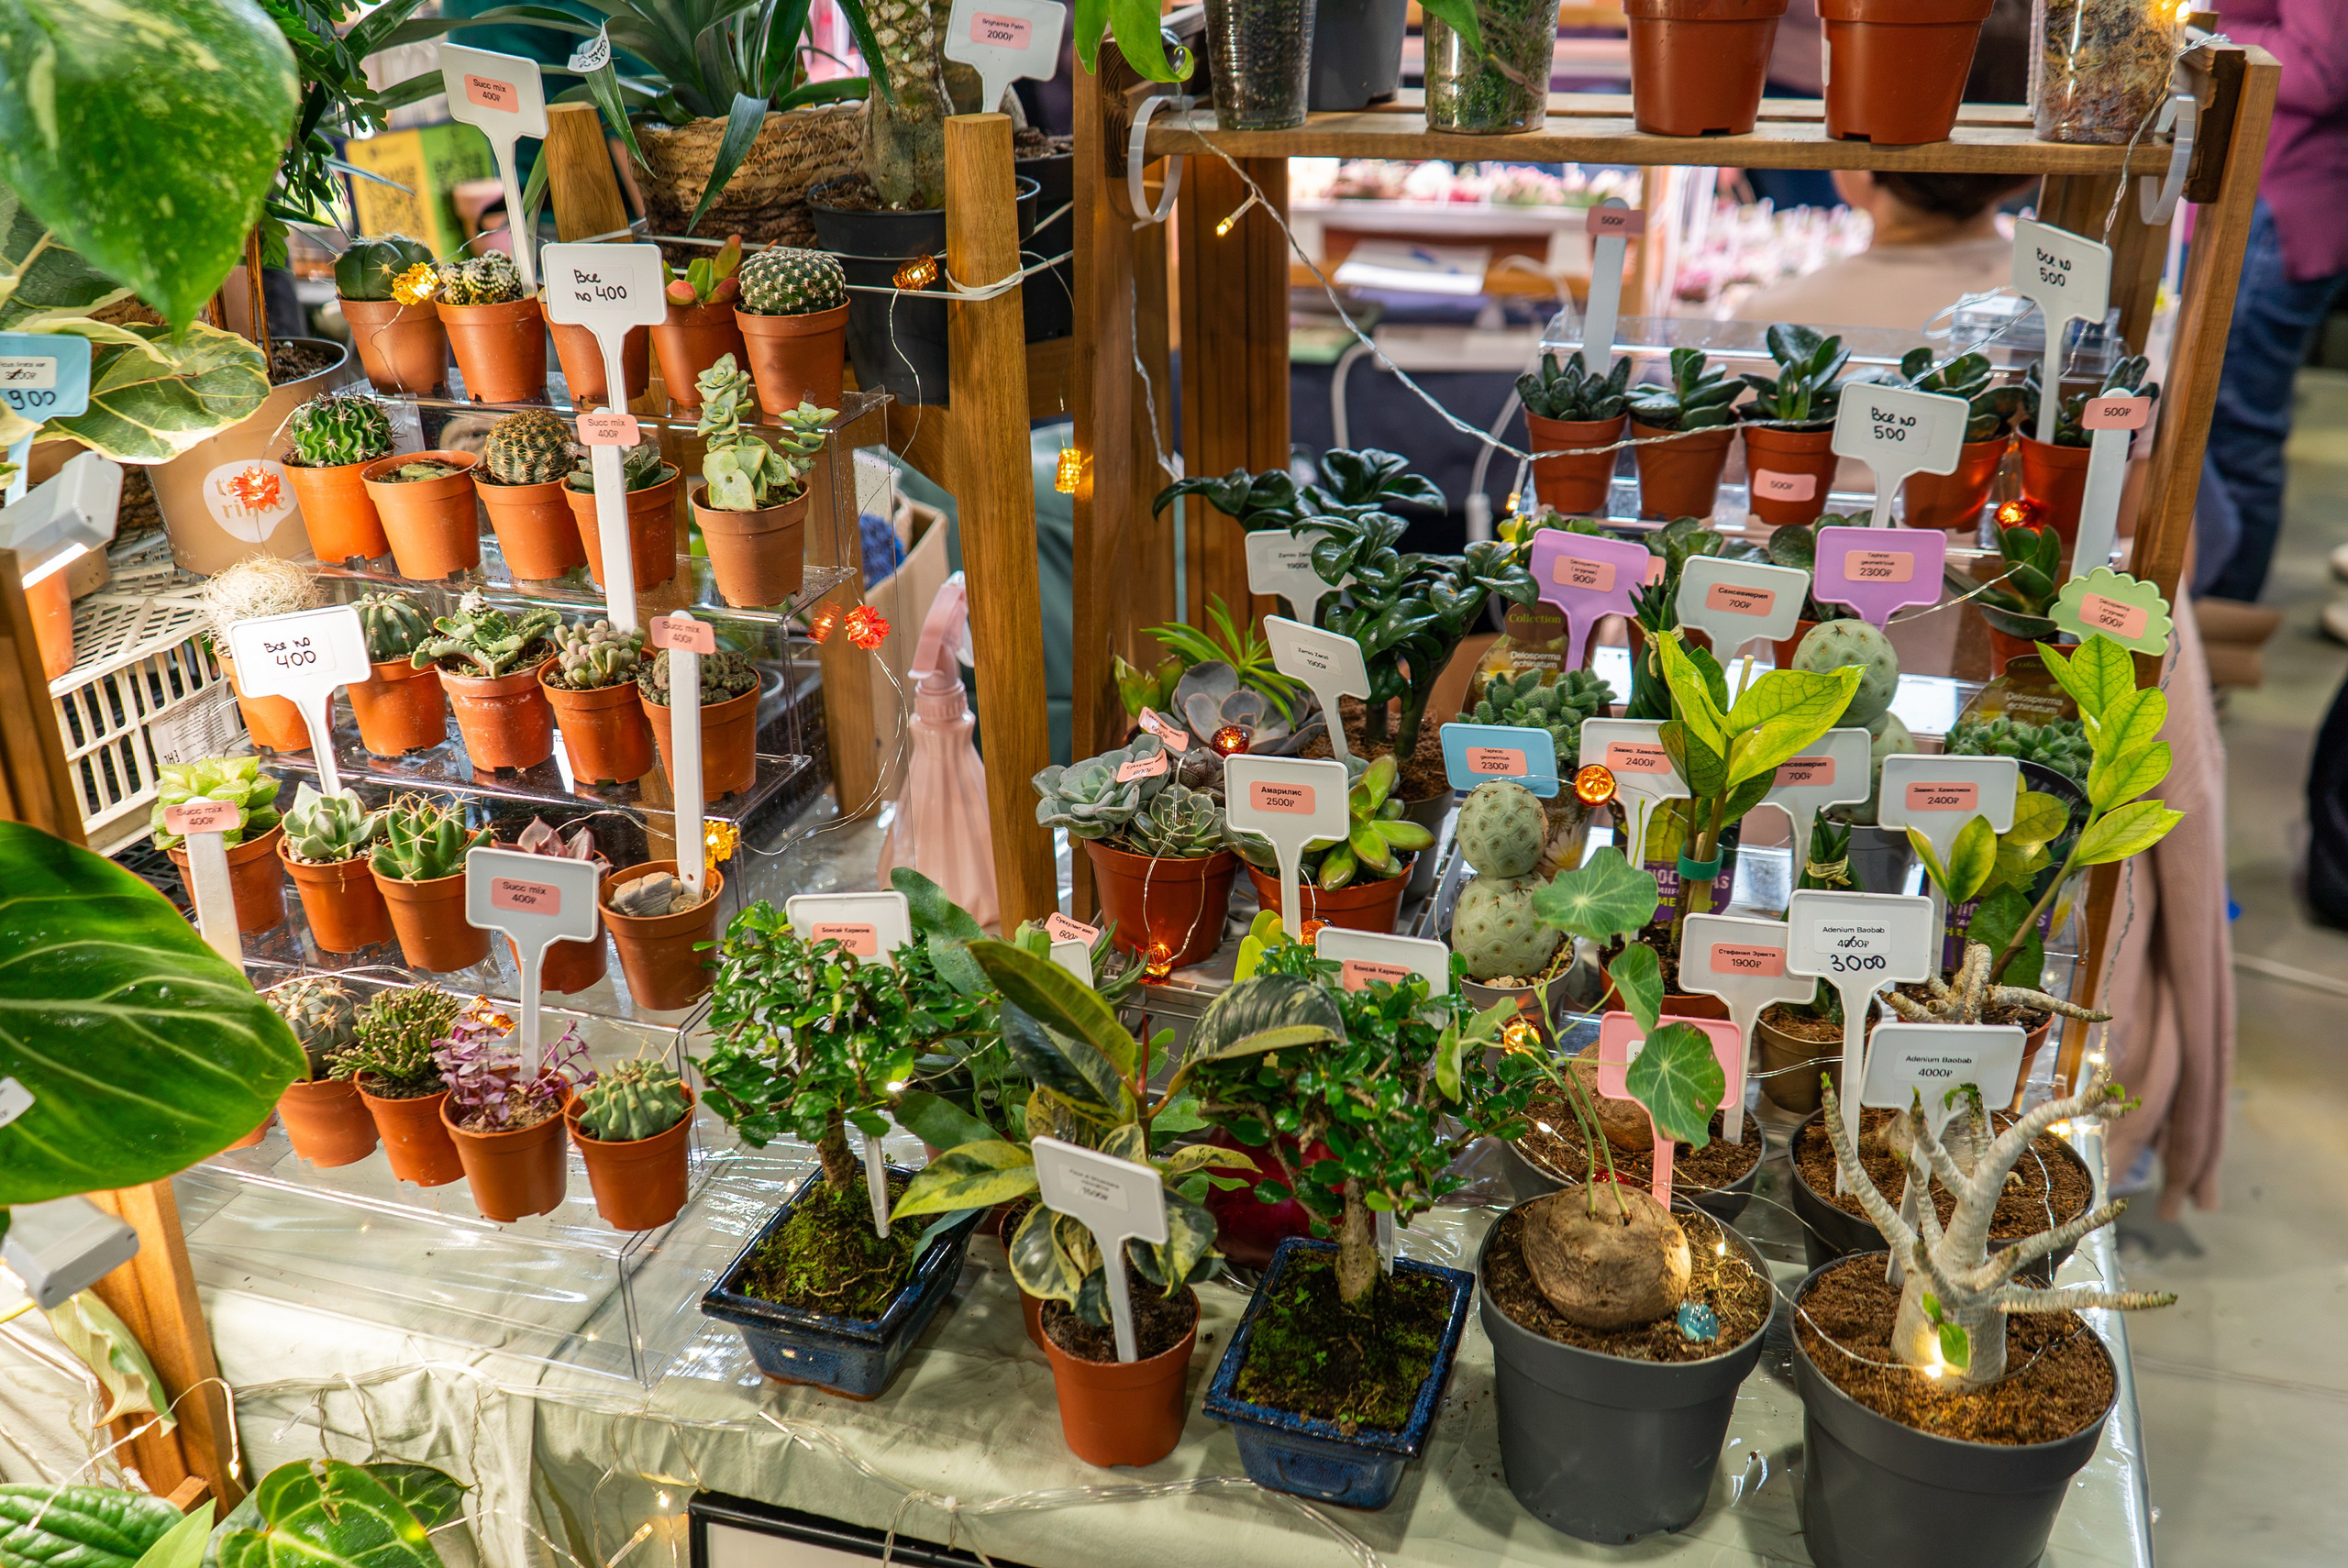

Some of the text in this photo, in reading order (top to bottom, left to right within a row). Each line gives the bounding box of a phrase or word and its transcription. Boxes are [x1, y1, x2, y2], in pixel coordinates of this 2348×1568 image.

[1010, 22, 1025, 30] Palm
[472, 78, 507, 94] Succ mix
[573, 269, 602, 284] Все
[2039, 266, 2066, 287] 500
[594, 285, 627, 302] 400
[587, 418, 626, 427] Succ mix
[1874, 425, 1906, 442] 500
[1508, 613, 1562, 624] Collection
[661, 620, 701, 634] Succ mix
[276, 649, 317, 669] 400
[1510, 650, 1562, 661] Delosperma
[1512, 659, 1558, 669] echinatum
[2005, 691, 2065, 707] Delosperma
[2007, 701, 2059, 714] echinatum
[1260, 786, 1302, 797] Амарилис
[176, 805, 224, 816] Succ mix
[502, 881, 547, 895] Succ mix
[1830, 954, 1887, 973] 3000
[1905, 1055, 1972, 1065] Adenium Baobab
